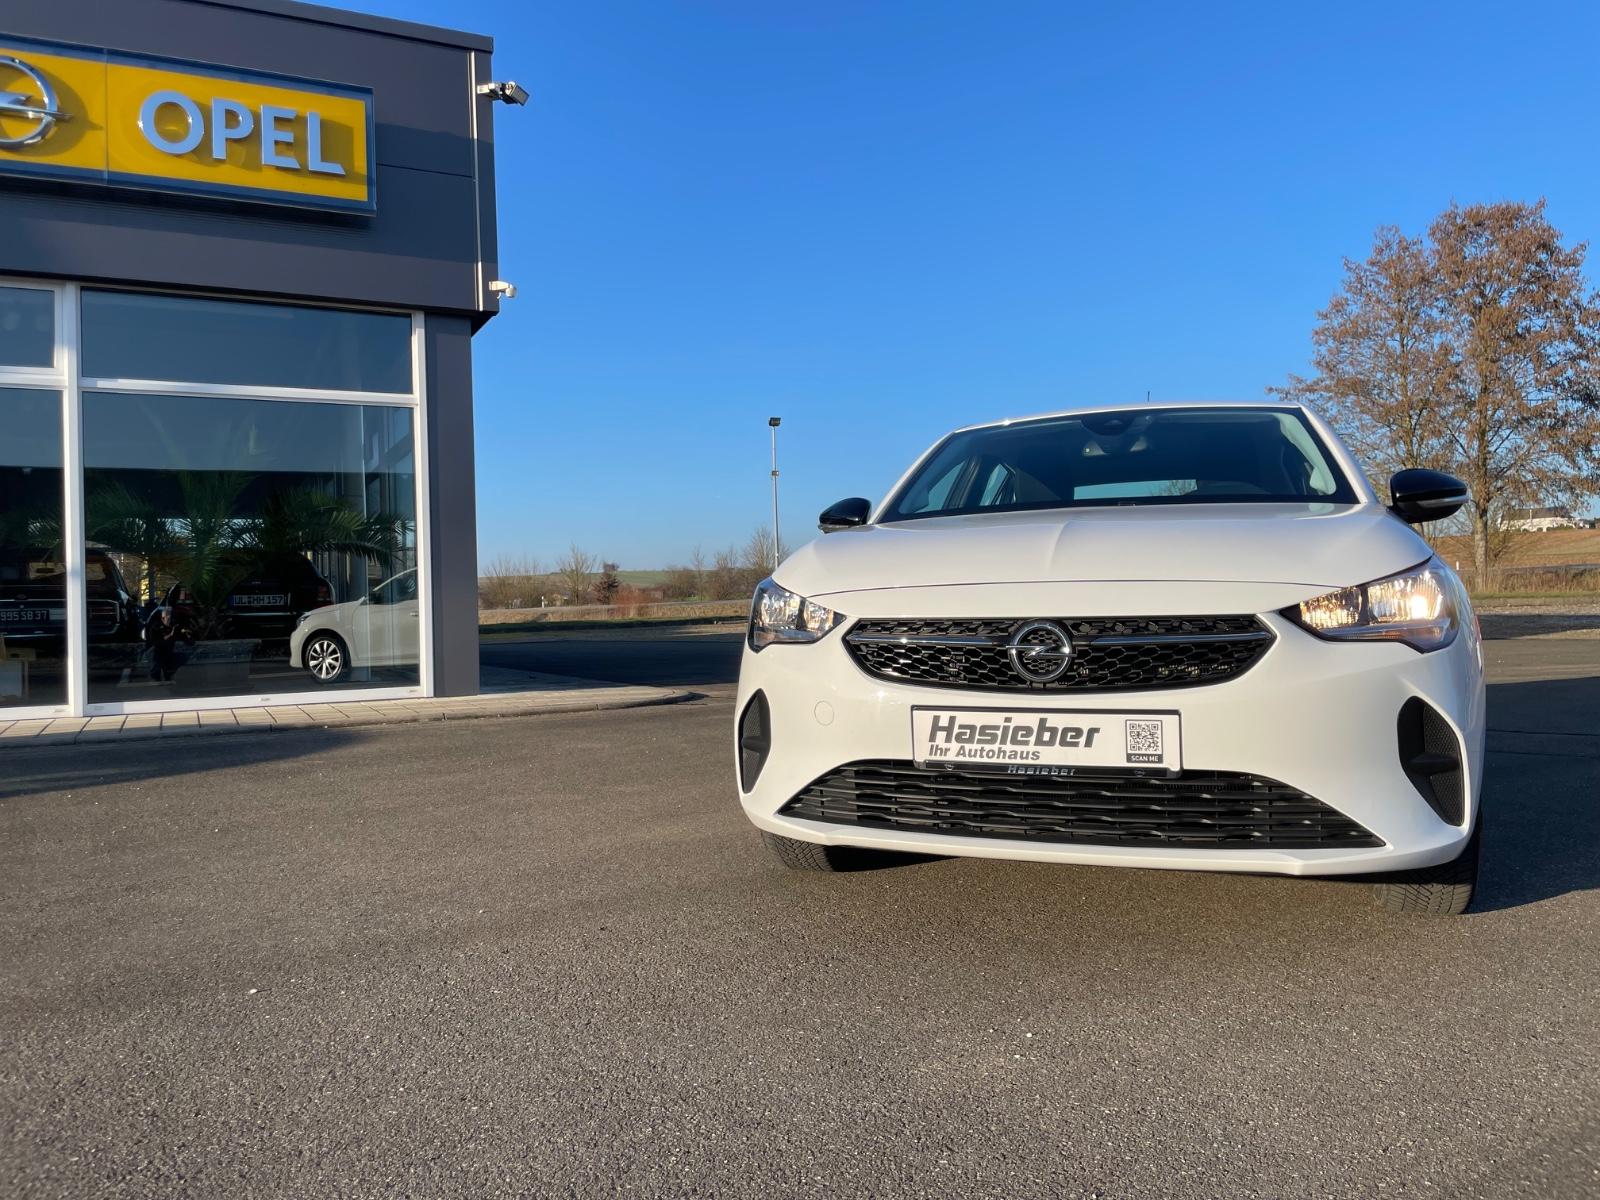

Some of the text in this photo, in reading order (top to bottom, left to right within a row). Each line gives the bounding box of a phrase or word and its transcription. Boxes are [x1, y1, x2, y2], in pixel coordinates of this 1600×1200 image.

[138, 89, 346, 176] OPEL
[928, 715, 1100, 748] Hasieber
[928, 744, 1041, 761] Ihr Autohaus
[1007, 764, 1076, 776] Hasieber
